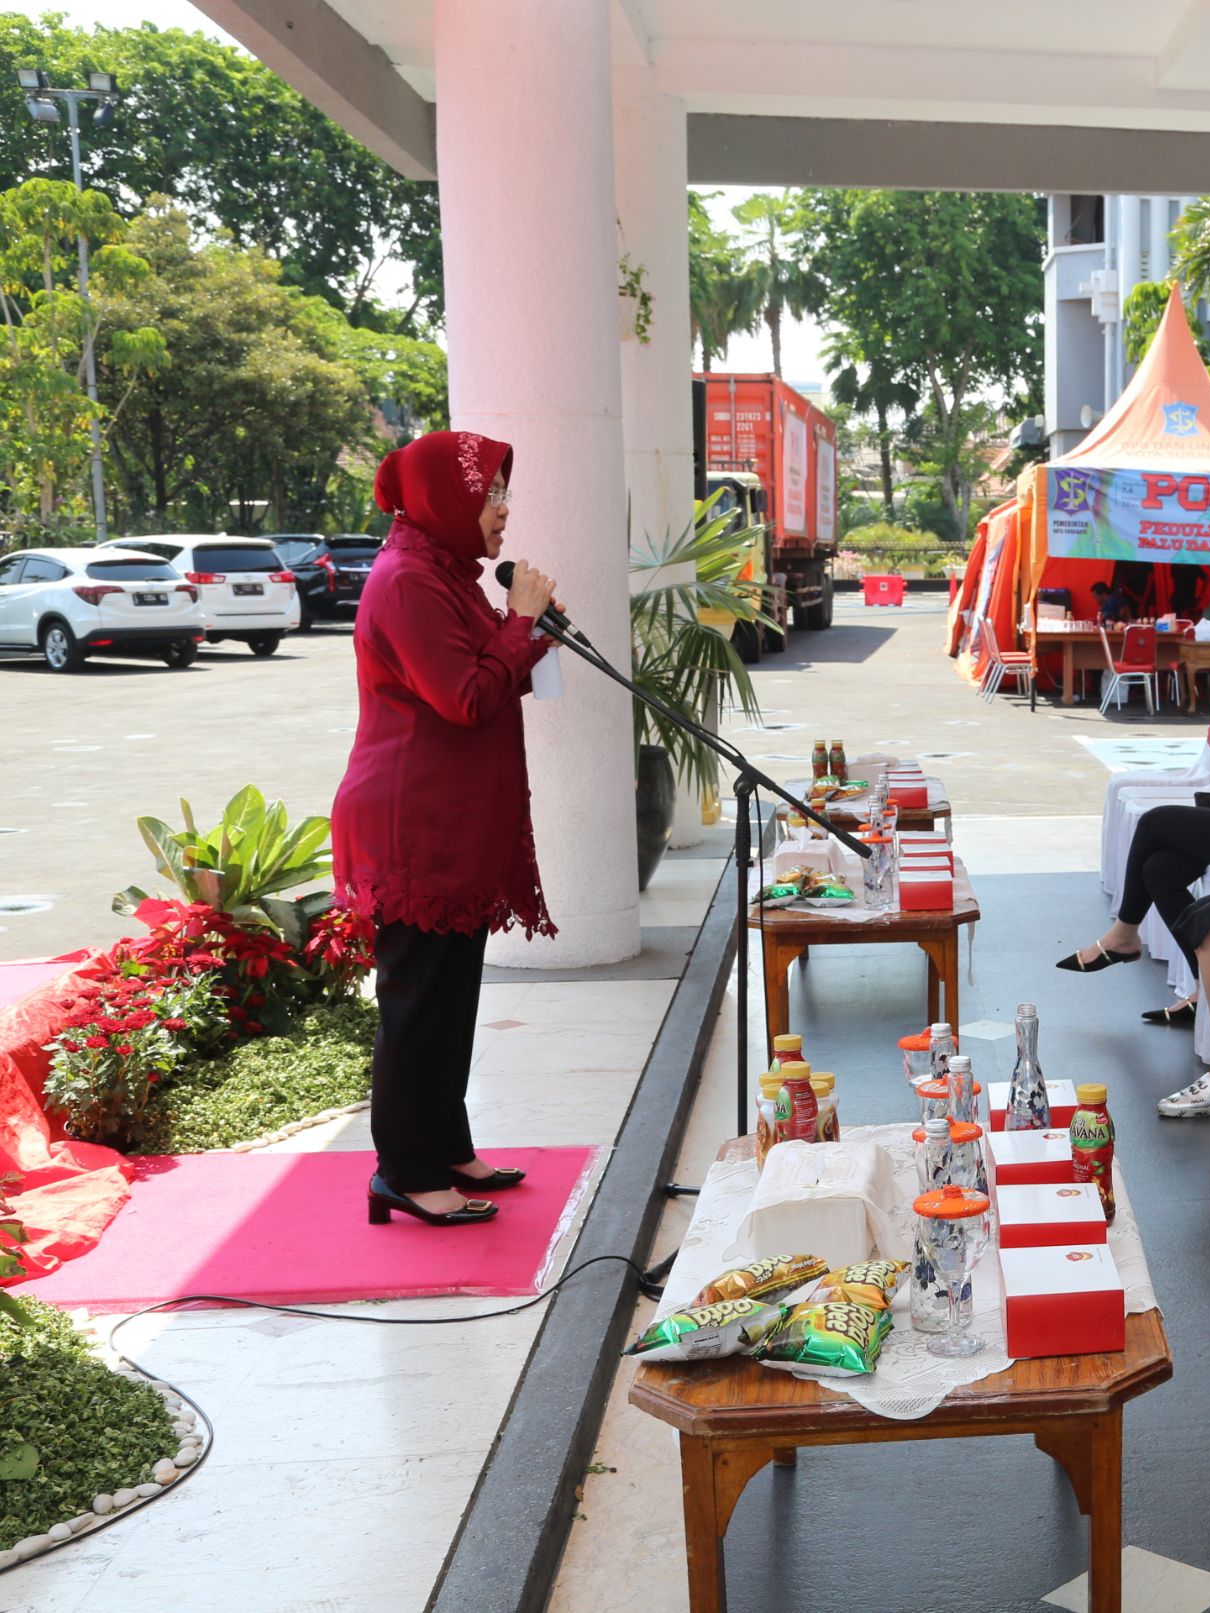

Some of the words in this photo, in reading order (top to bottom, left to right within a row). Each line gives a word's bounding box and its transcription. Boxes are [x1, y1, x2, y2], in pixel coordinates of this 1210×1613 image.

[1138, 536, 1184, 550] PALU
[824, 1301, 858, 1337] bee
[846, 1301, 876, 1349] Pota
